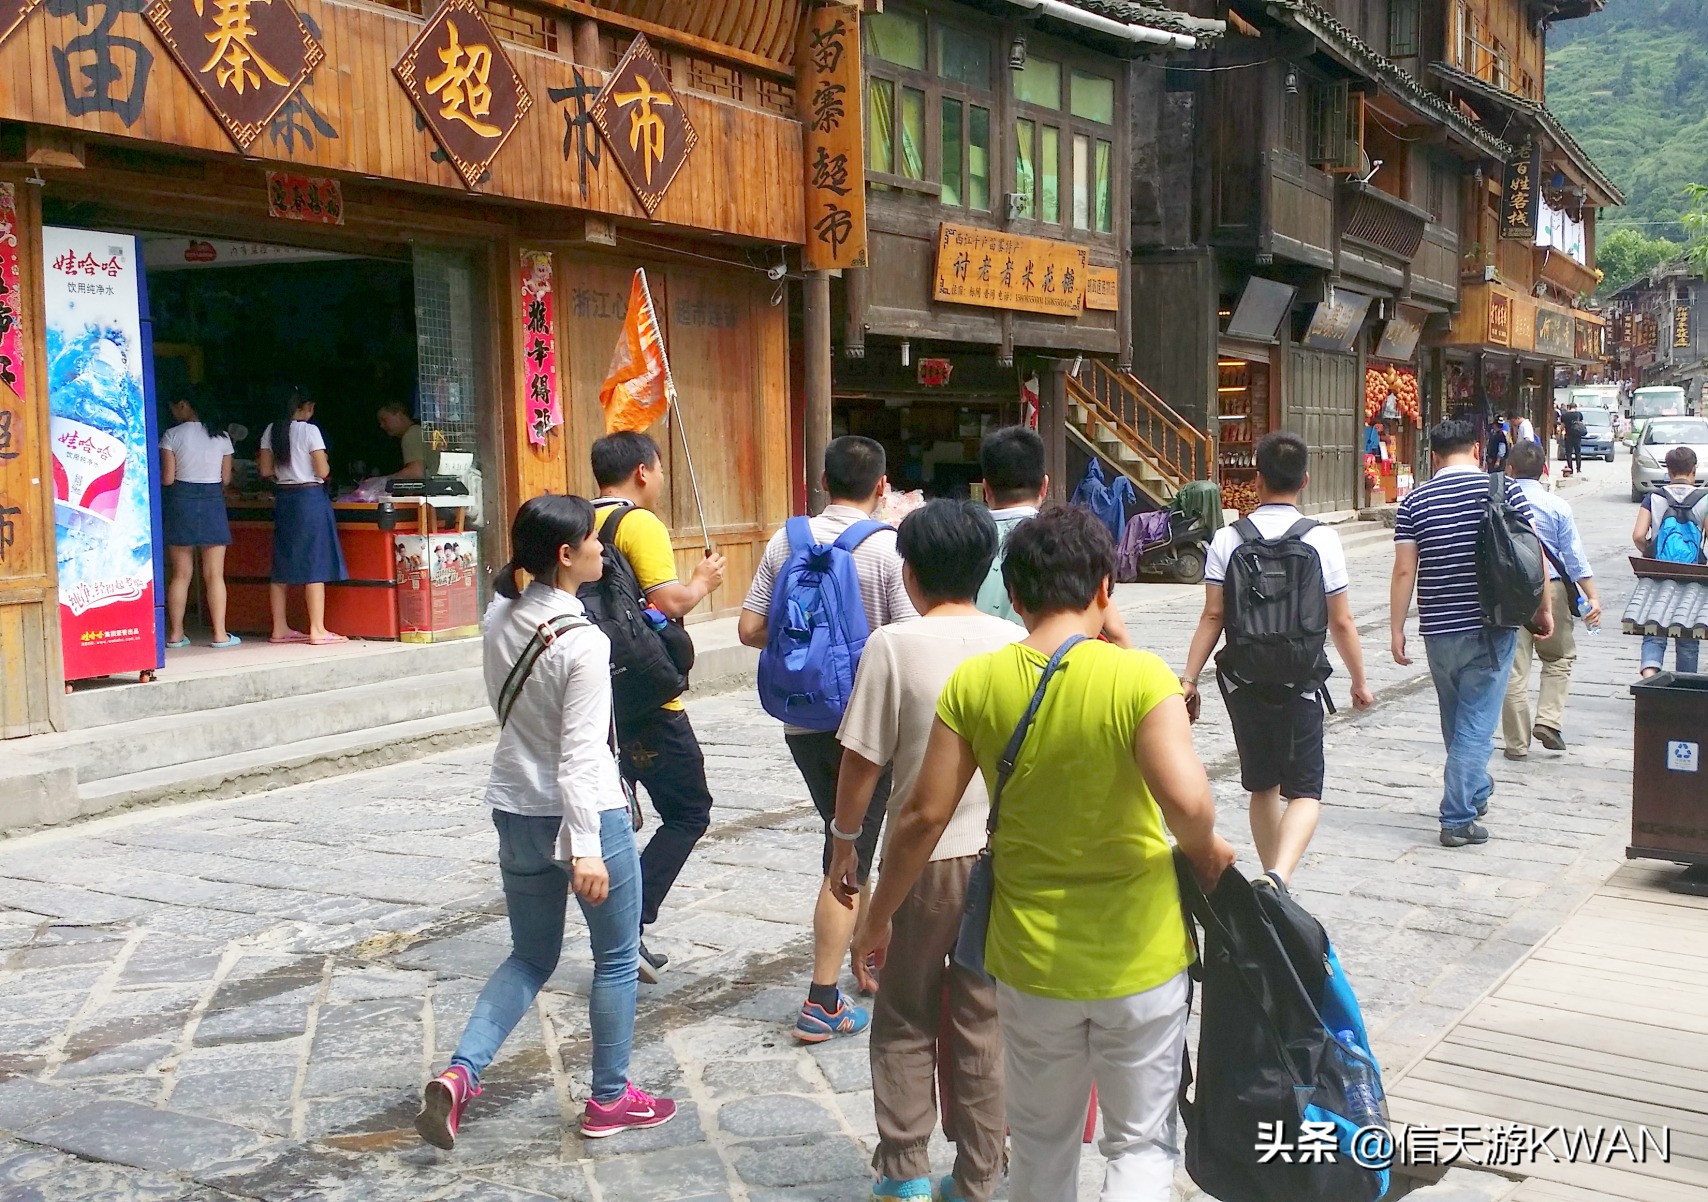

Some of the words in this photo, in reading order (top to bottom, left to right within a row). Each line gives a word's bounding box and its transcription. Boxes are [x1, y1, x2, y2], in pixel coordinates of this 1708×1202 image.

[809, 19, 853, 261] 苗寨超市
[1507, 145, 1532, 227] 老百姓客栈
[52, 248, 123, 278] 娃哈哈
[67, 281, 115, 296] 饮用纯净水
[57, 429, 113, 461] 娃哈哈
